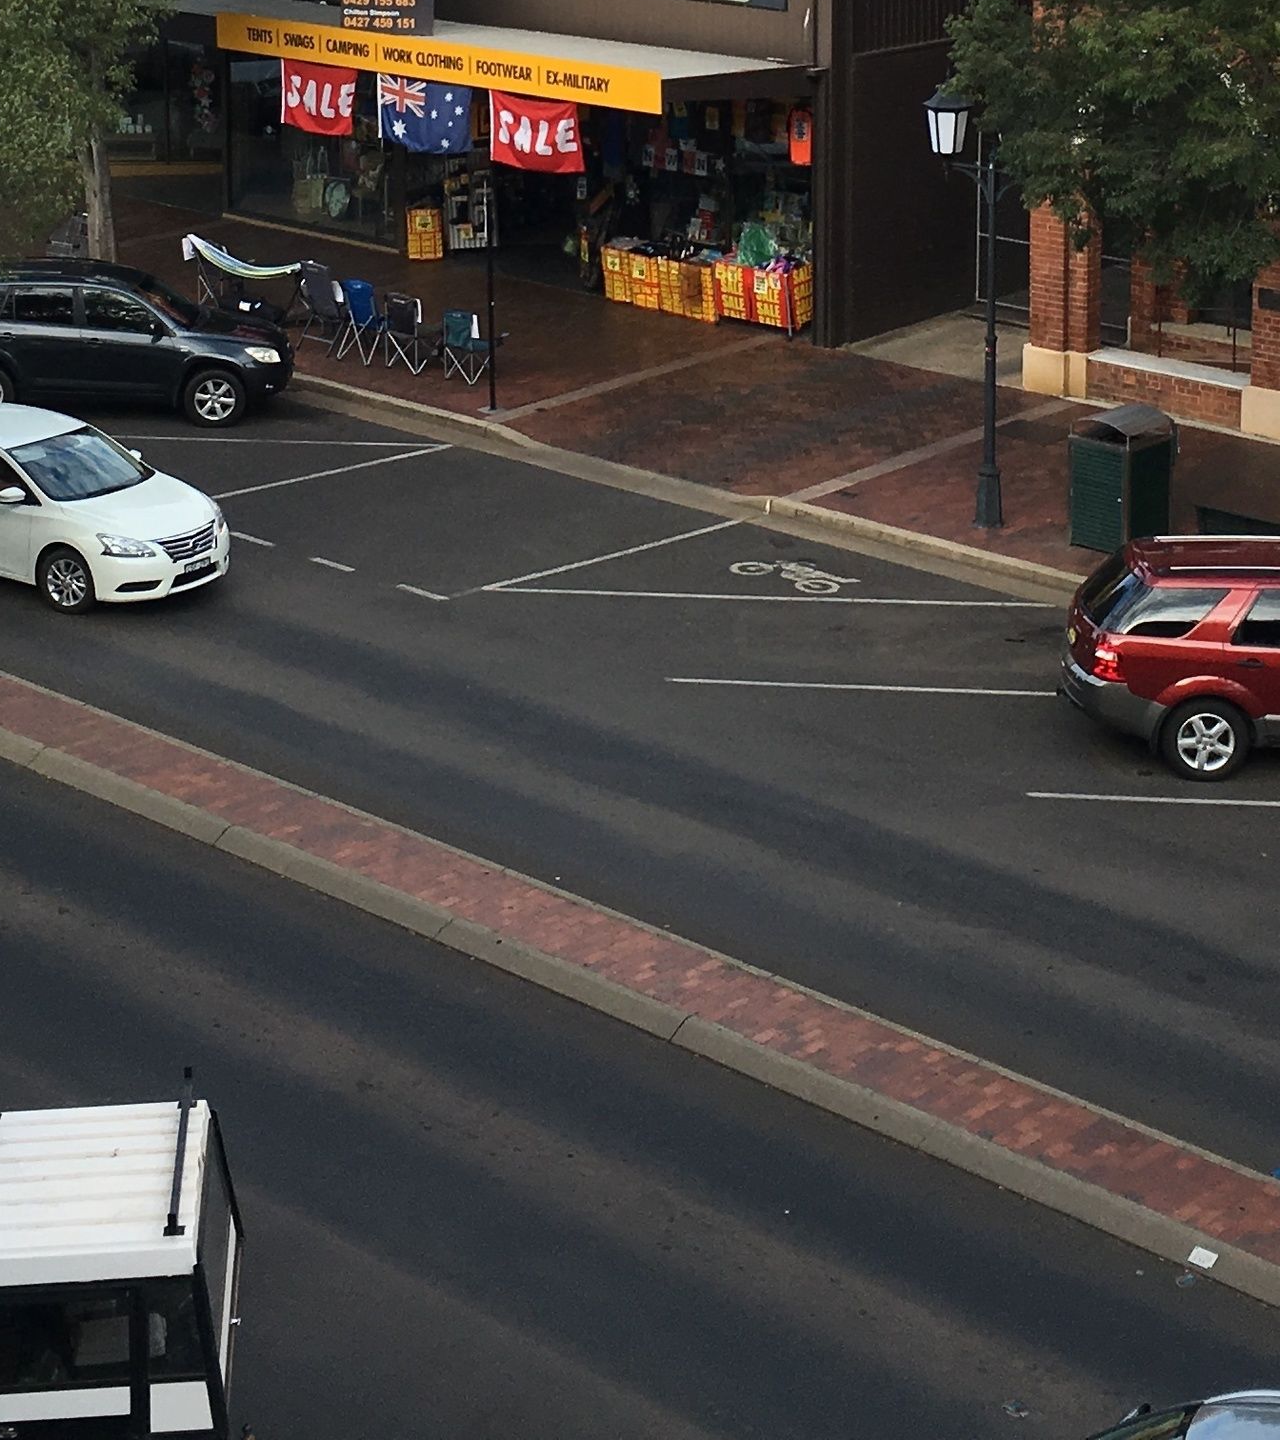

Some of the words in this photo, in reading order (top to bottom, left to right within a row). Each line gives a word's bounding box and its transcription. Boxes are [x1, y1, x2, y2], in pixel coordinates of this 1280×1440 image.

[344, 17, 370, 27] 0427
[373, 18, 393, 29] 459
[397, 18, 416, 29] 151
[247, 27, 273, 44] TENTS
[284, 32, 315, 50] SWAGS
[326, 38, 370, 58] CAMPING
[382, 47, 413, 65] WORK
[415, 51, 464, 71] CLOTHING
[476, 60, 532, 82] FOOTWEAR
[546, 70, 610, 93] EX-MILITARY
[286, 75, 356, 119] SALE
[499, 110, 578, 156] SALE
